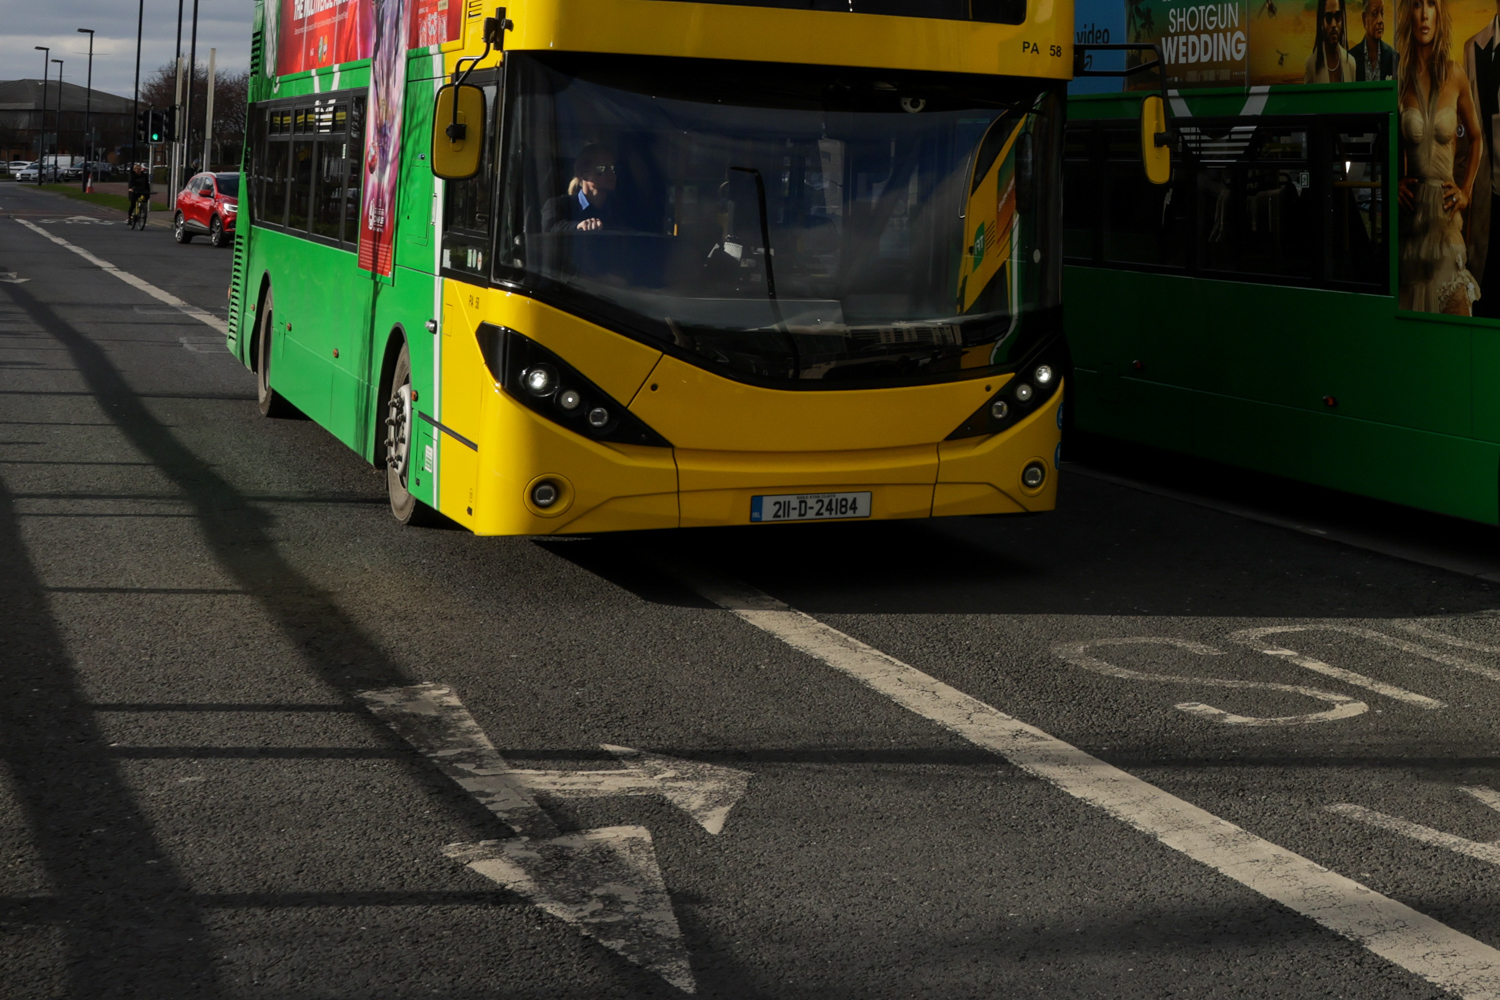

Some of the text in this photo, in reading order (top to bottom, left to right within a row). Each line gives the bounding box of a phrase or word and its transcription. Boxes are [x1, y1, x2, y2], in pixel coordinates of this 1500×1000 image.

[1168, 2, 1240, 33] SHOTGUN
[1076, 23, 1110, 45] video
[1022, 41, 1062, 58] PA 58
[1161, 30, 1247, 65] WEDDING
[772, 497, 858, 519] 211-D-24184
